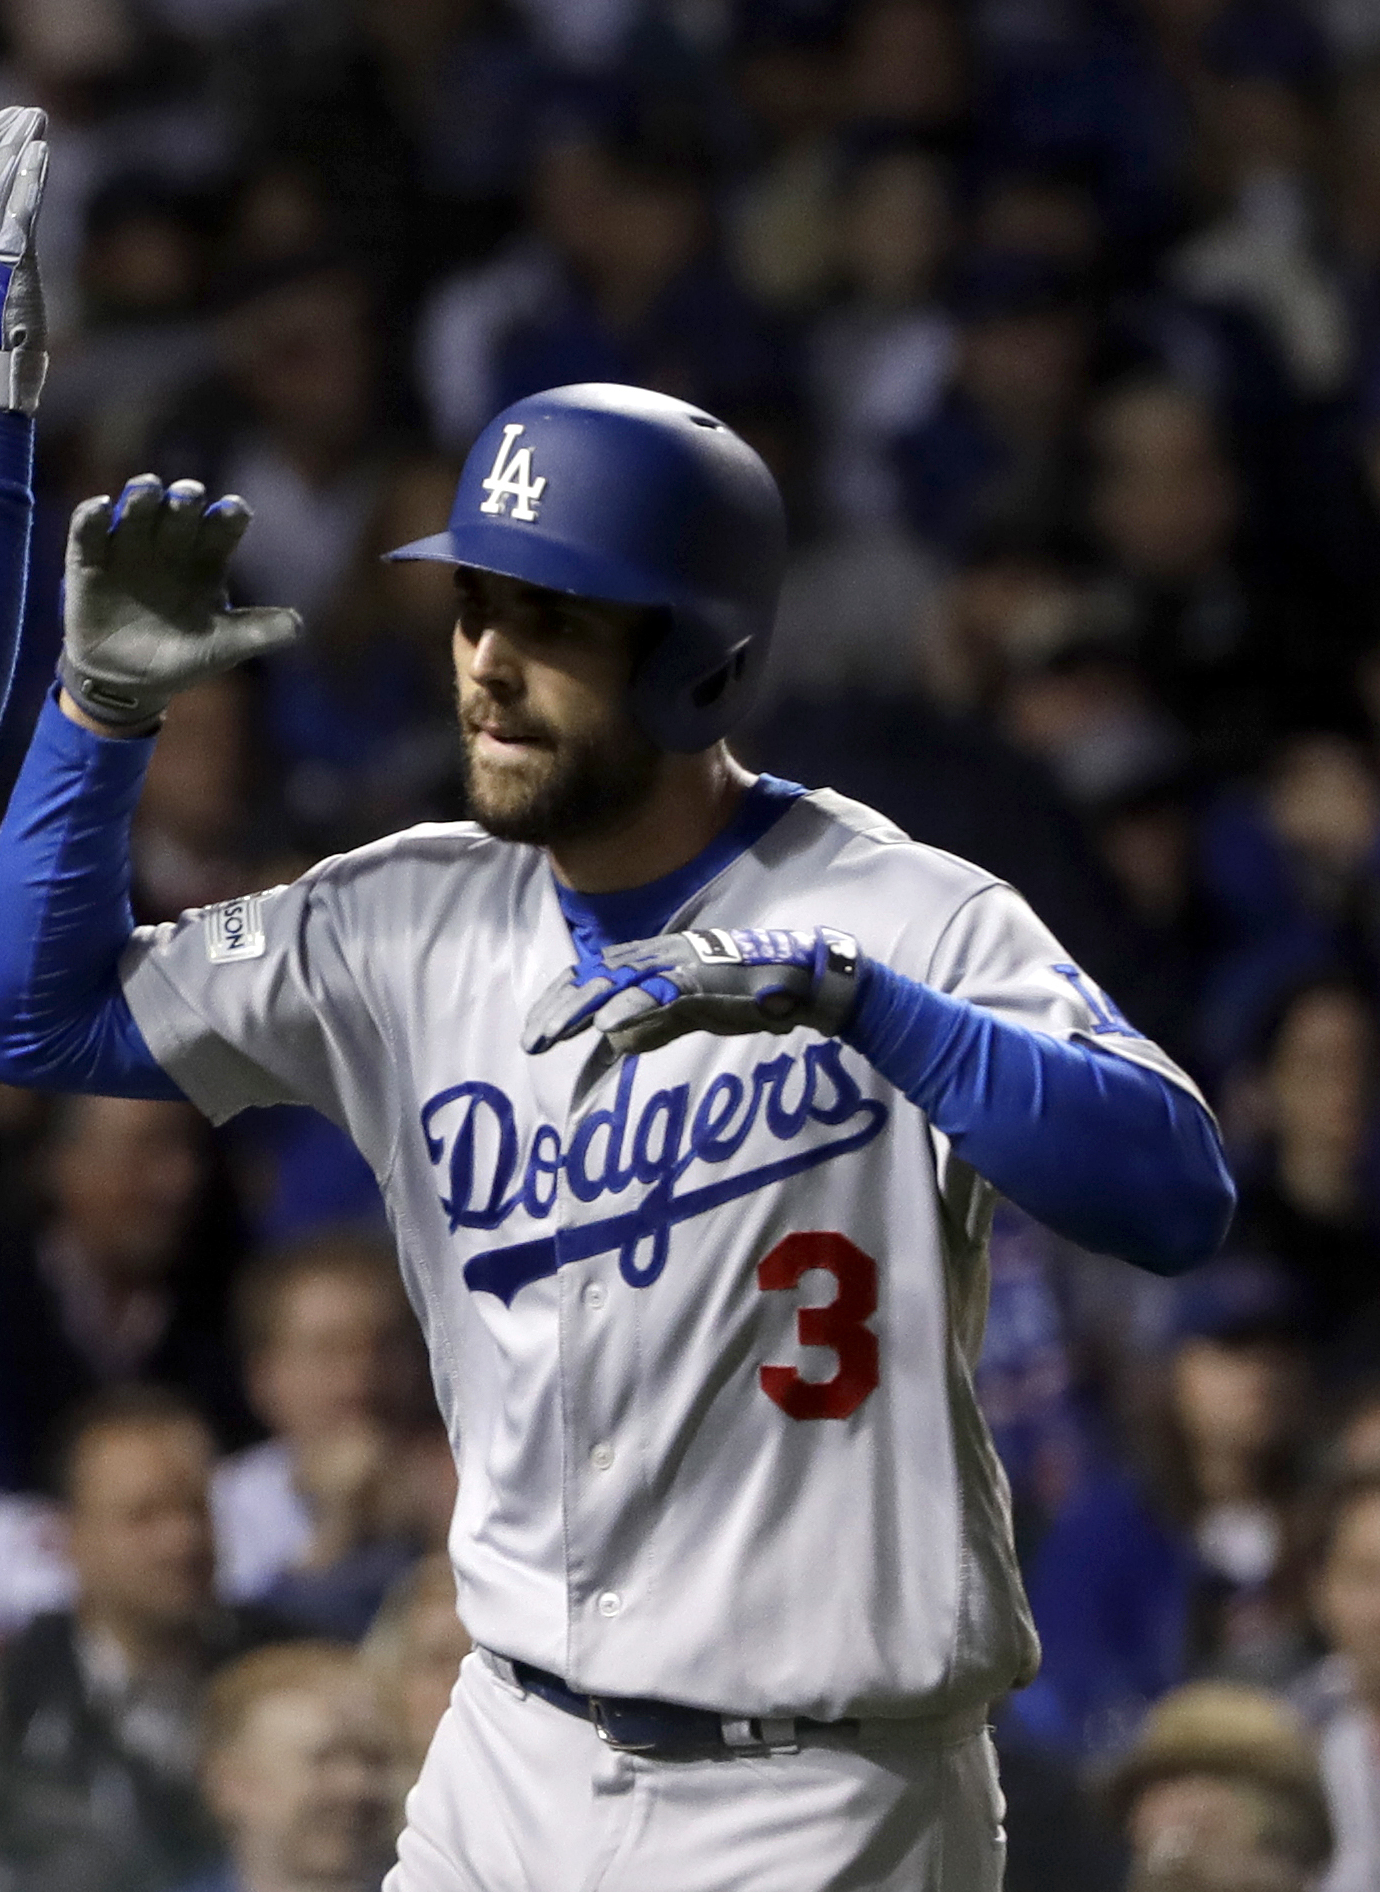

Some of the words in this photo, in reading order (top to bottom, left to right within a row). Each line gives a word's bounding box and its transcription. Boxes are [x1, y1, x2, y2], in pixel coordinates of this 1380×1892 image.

[480, 423, 547, 522] LA
[224, 901, 244, 951] SON
[420, 1038, 888, 1308] Dodgers
[757, 1230, 880, 1421] 3
